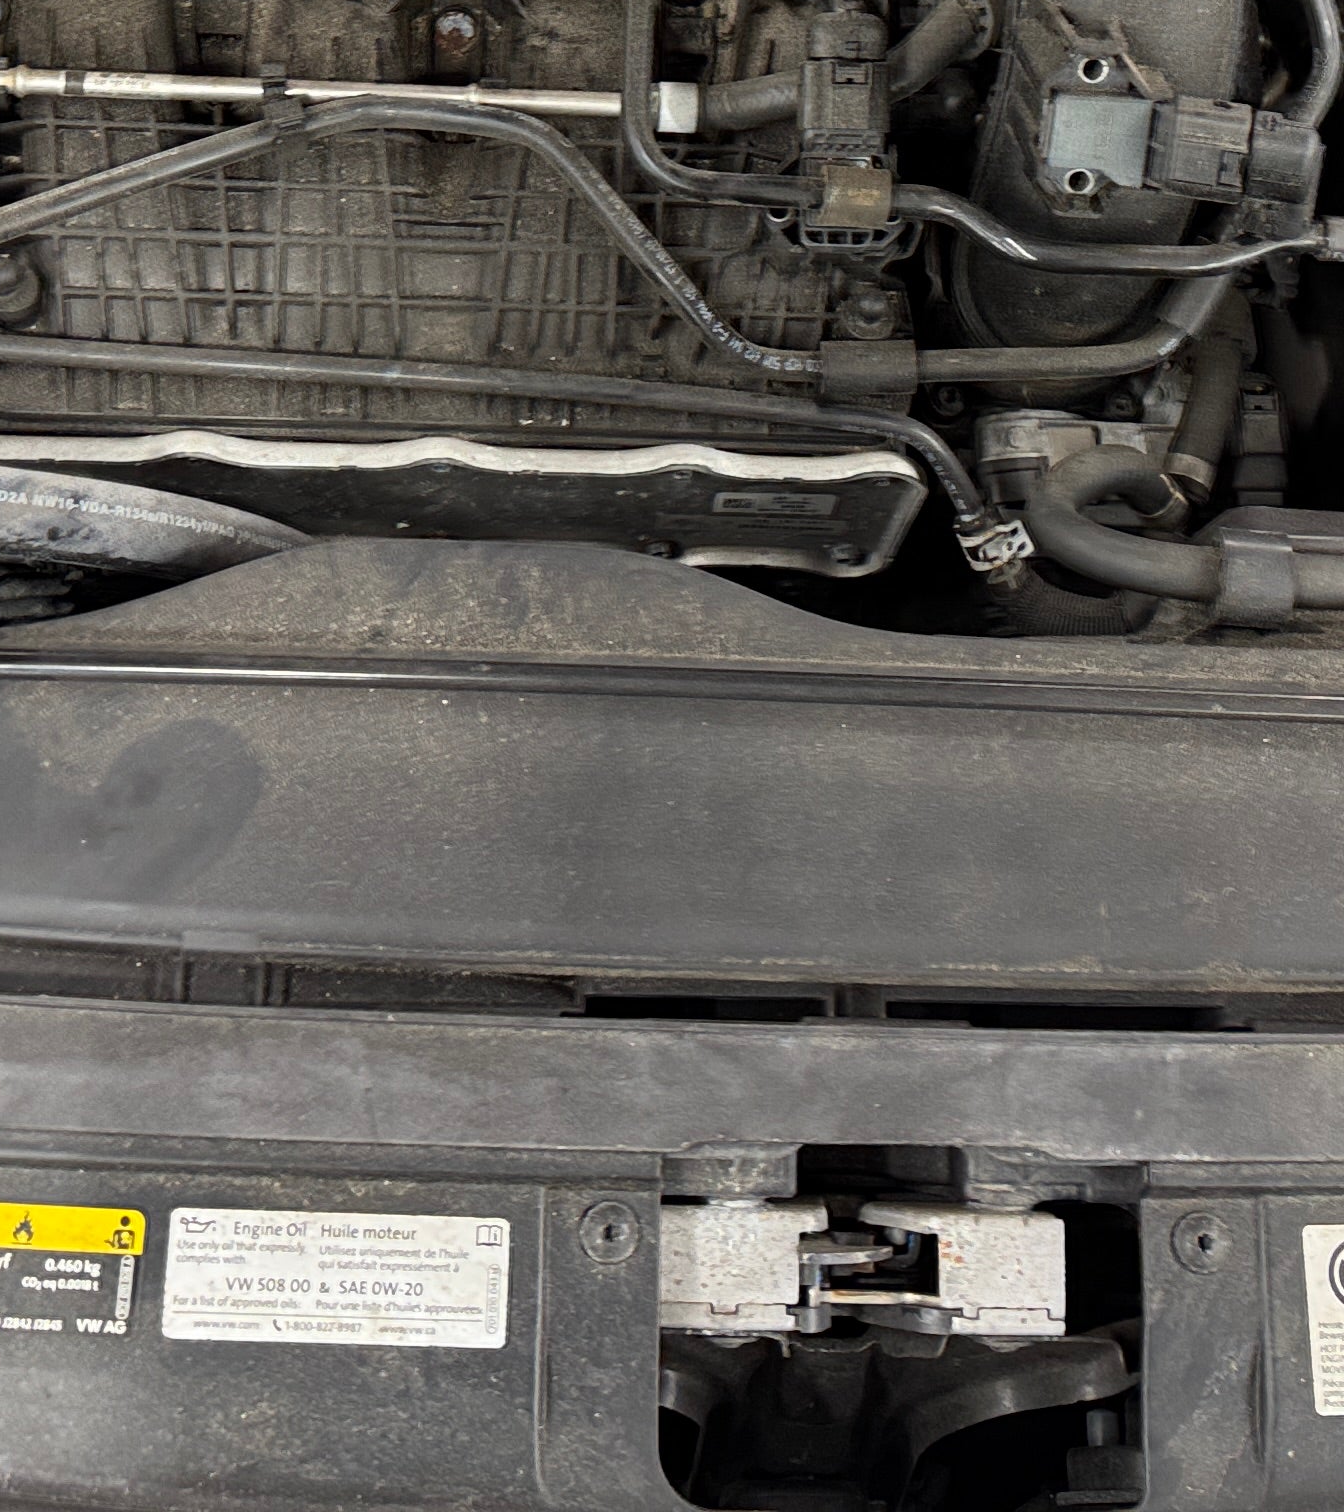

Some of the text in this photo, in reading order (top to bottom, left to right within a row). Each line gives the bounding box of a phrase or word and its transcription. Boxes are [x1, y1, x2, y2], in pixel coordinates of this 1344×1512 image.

[234, 1221, 306, 1239] Engine Oil
[320, 1224, 417, 1240] Huile moteur
[177, 1240, 197, 1250] Use
[198, 1240, 219, 1253] only
[221, 1240, 235, 1251] oil
[236, 1241, 257, 1251] that
[319, 1245, 356, 1256] Utilisez
[359, 1246, 421, 1259] uniquement
[423, 1248, 438, 1258] de
[176, 1254, 221, 1266] complies
[318, 1260, 334, 1272] qui
[44, 1258, 82, 1273] 0.460
[84, 1259, 102, 1278] kg
[226, 1277, 423, 1296] VW 508 00 & SAE 0W-20
[172, 1294, 189, 1306] For
[191, 1297, 198, 1306] a
[199, 1295, 216, 1306] list
[217, 1296, 229, 1307] of
[230, 1297, 278, 1309] approved
[316, 1299, 337, 1310] Pour
[340, 1301, 360, 1311] une
[76, 1318, 127, 1334] VW AG
